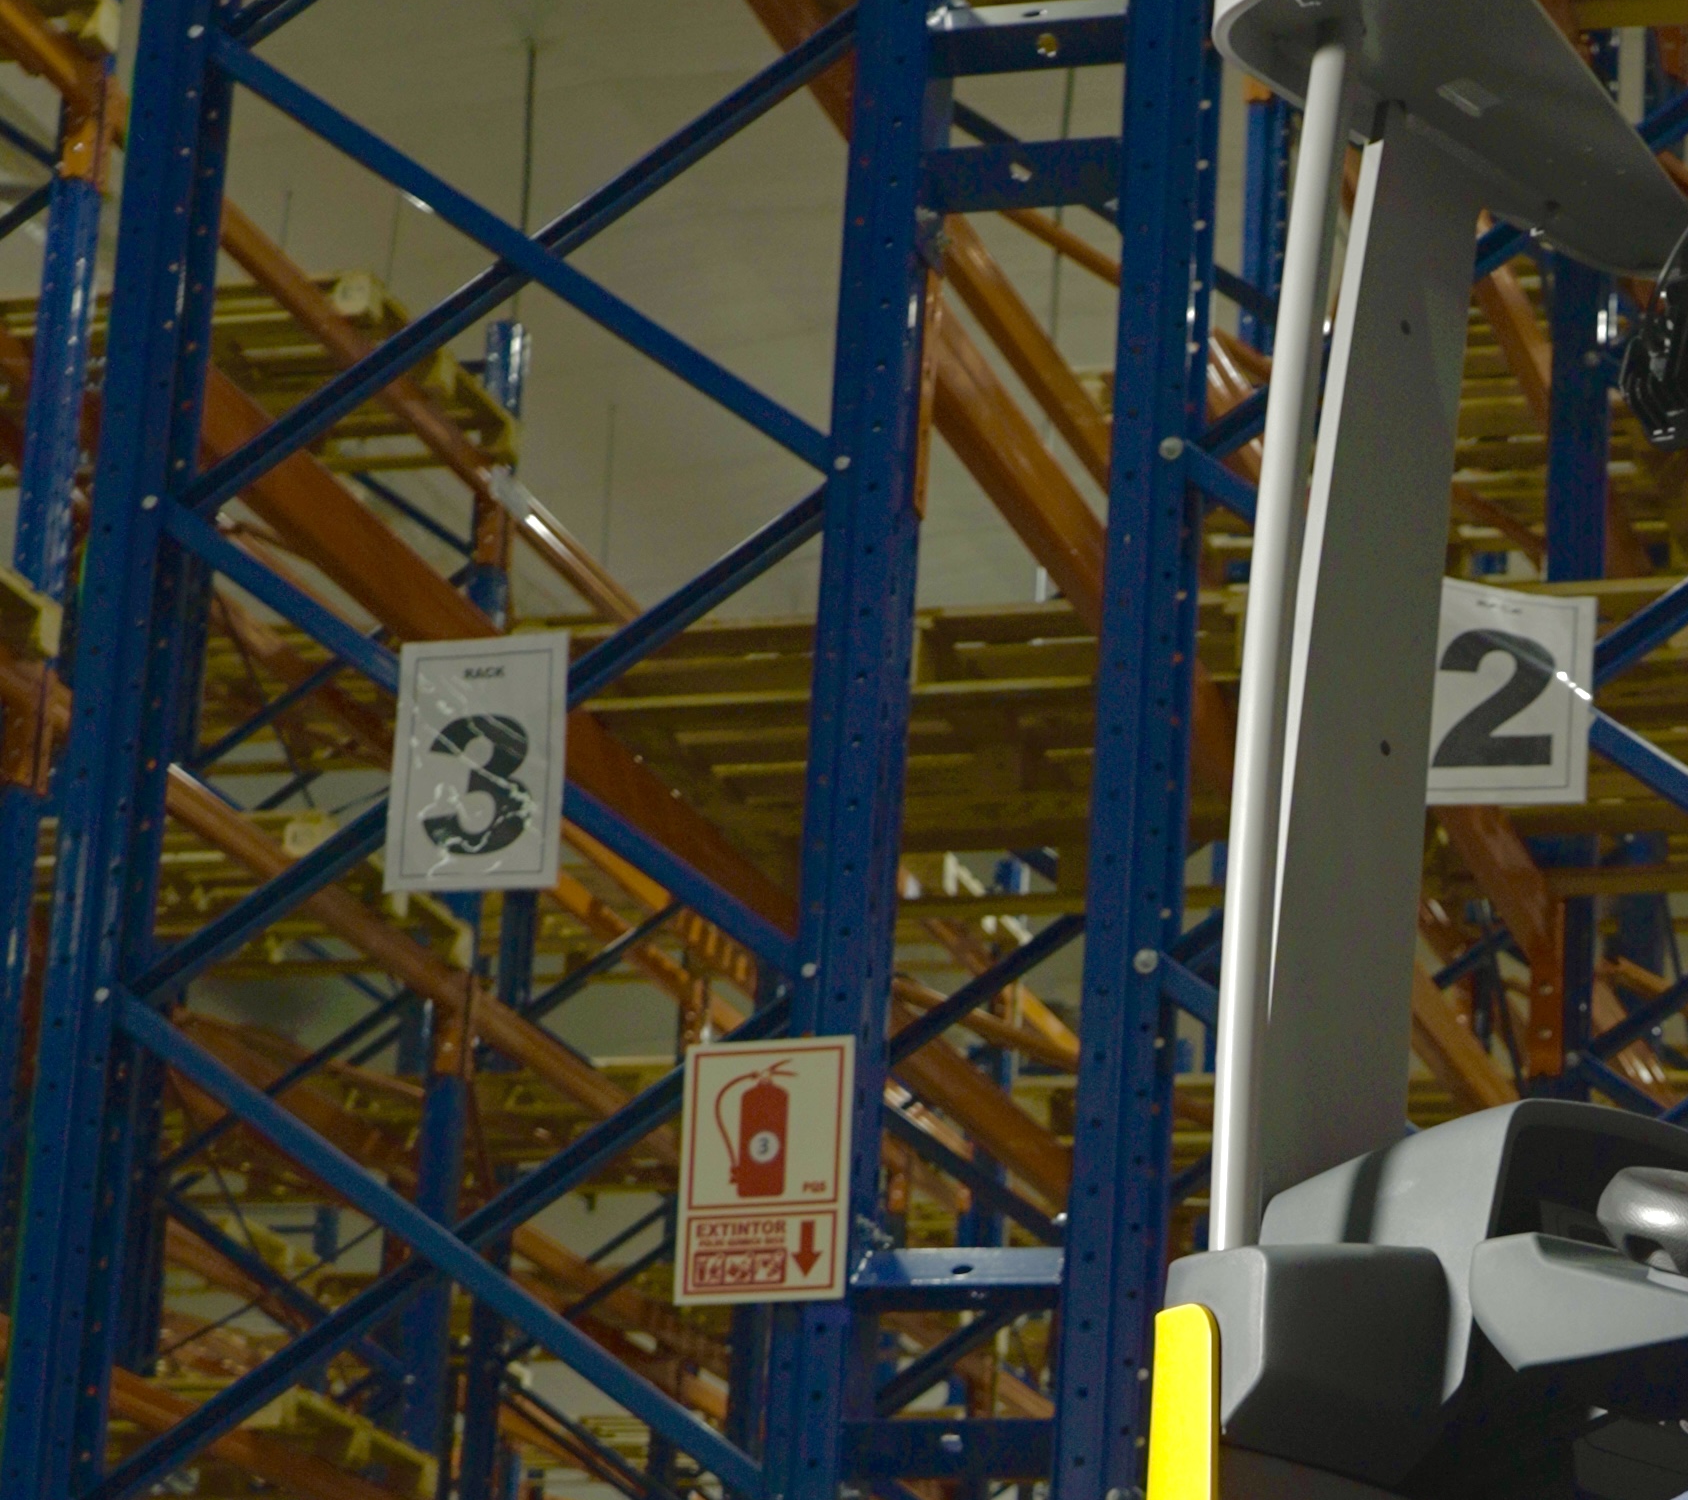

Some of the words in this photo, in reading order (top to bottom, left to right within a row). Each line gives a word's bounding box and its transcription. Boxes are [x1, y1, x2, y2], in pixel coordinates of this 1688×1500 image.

[464, 665, 506, 680] RACK
[1432, 628, 1555, 768] 2
[423, 713, 529, 856] 3
[759, 1136, 769, 1155] 3
[696, 1220, 786, 1239] EXTINTOR
